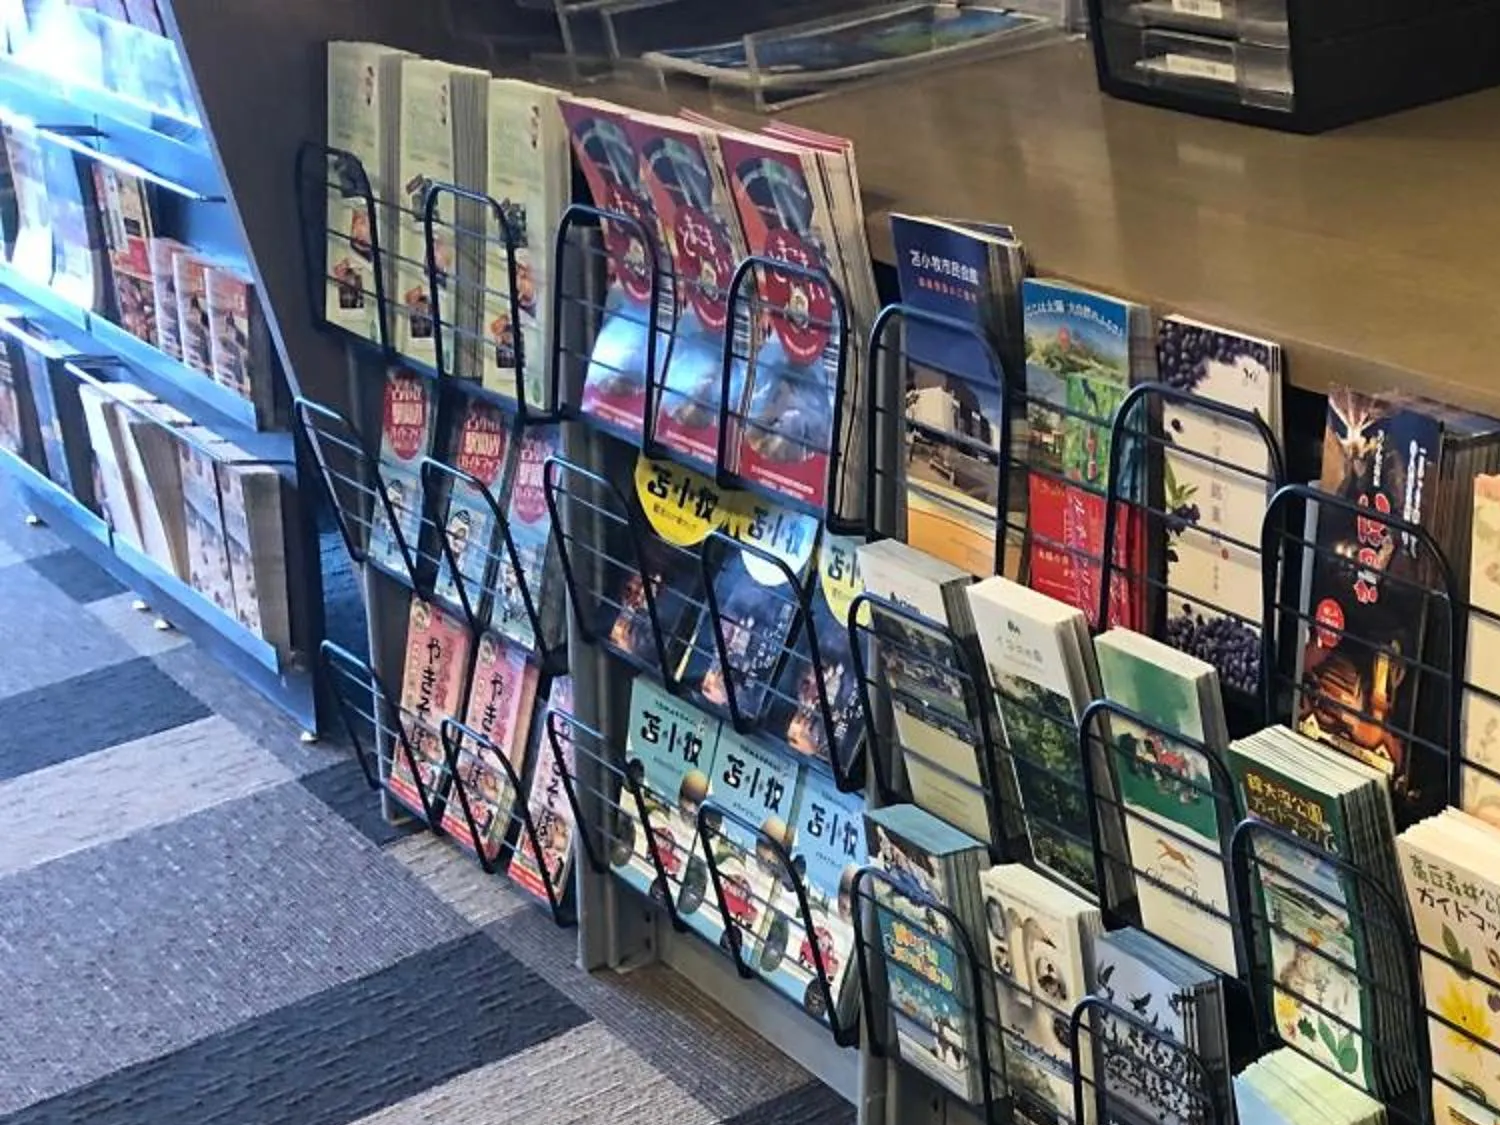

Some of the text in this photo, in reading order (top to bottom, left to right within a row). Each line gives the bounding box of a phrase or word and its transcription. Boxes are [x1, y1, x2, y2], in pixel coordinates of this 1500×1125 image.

[640, 709, 703, 767] 苫小牧
[722, 753, 785, 814] 苫小牧
[806, 802, 859, 861] 苫小牧
